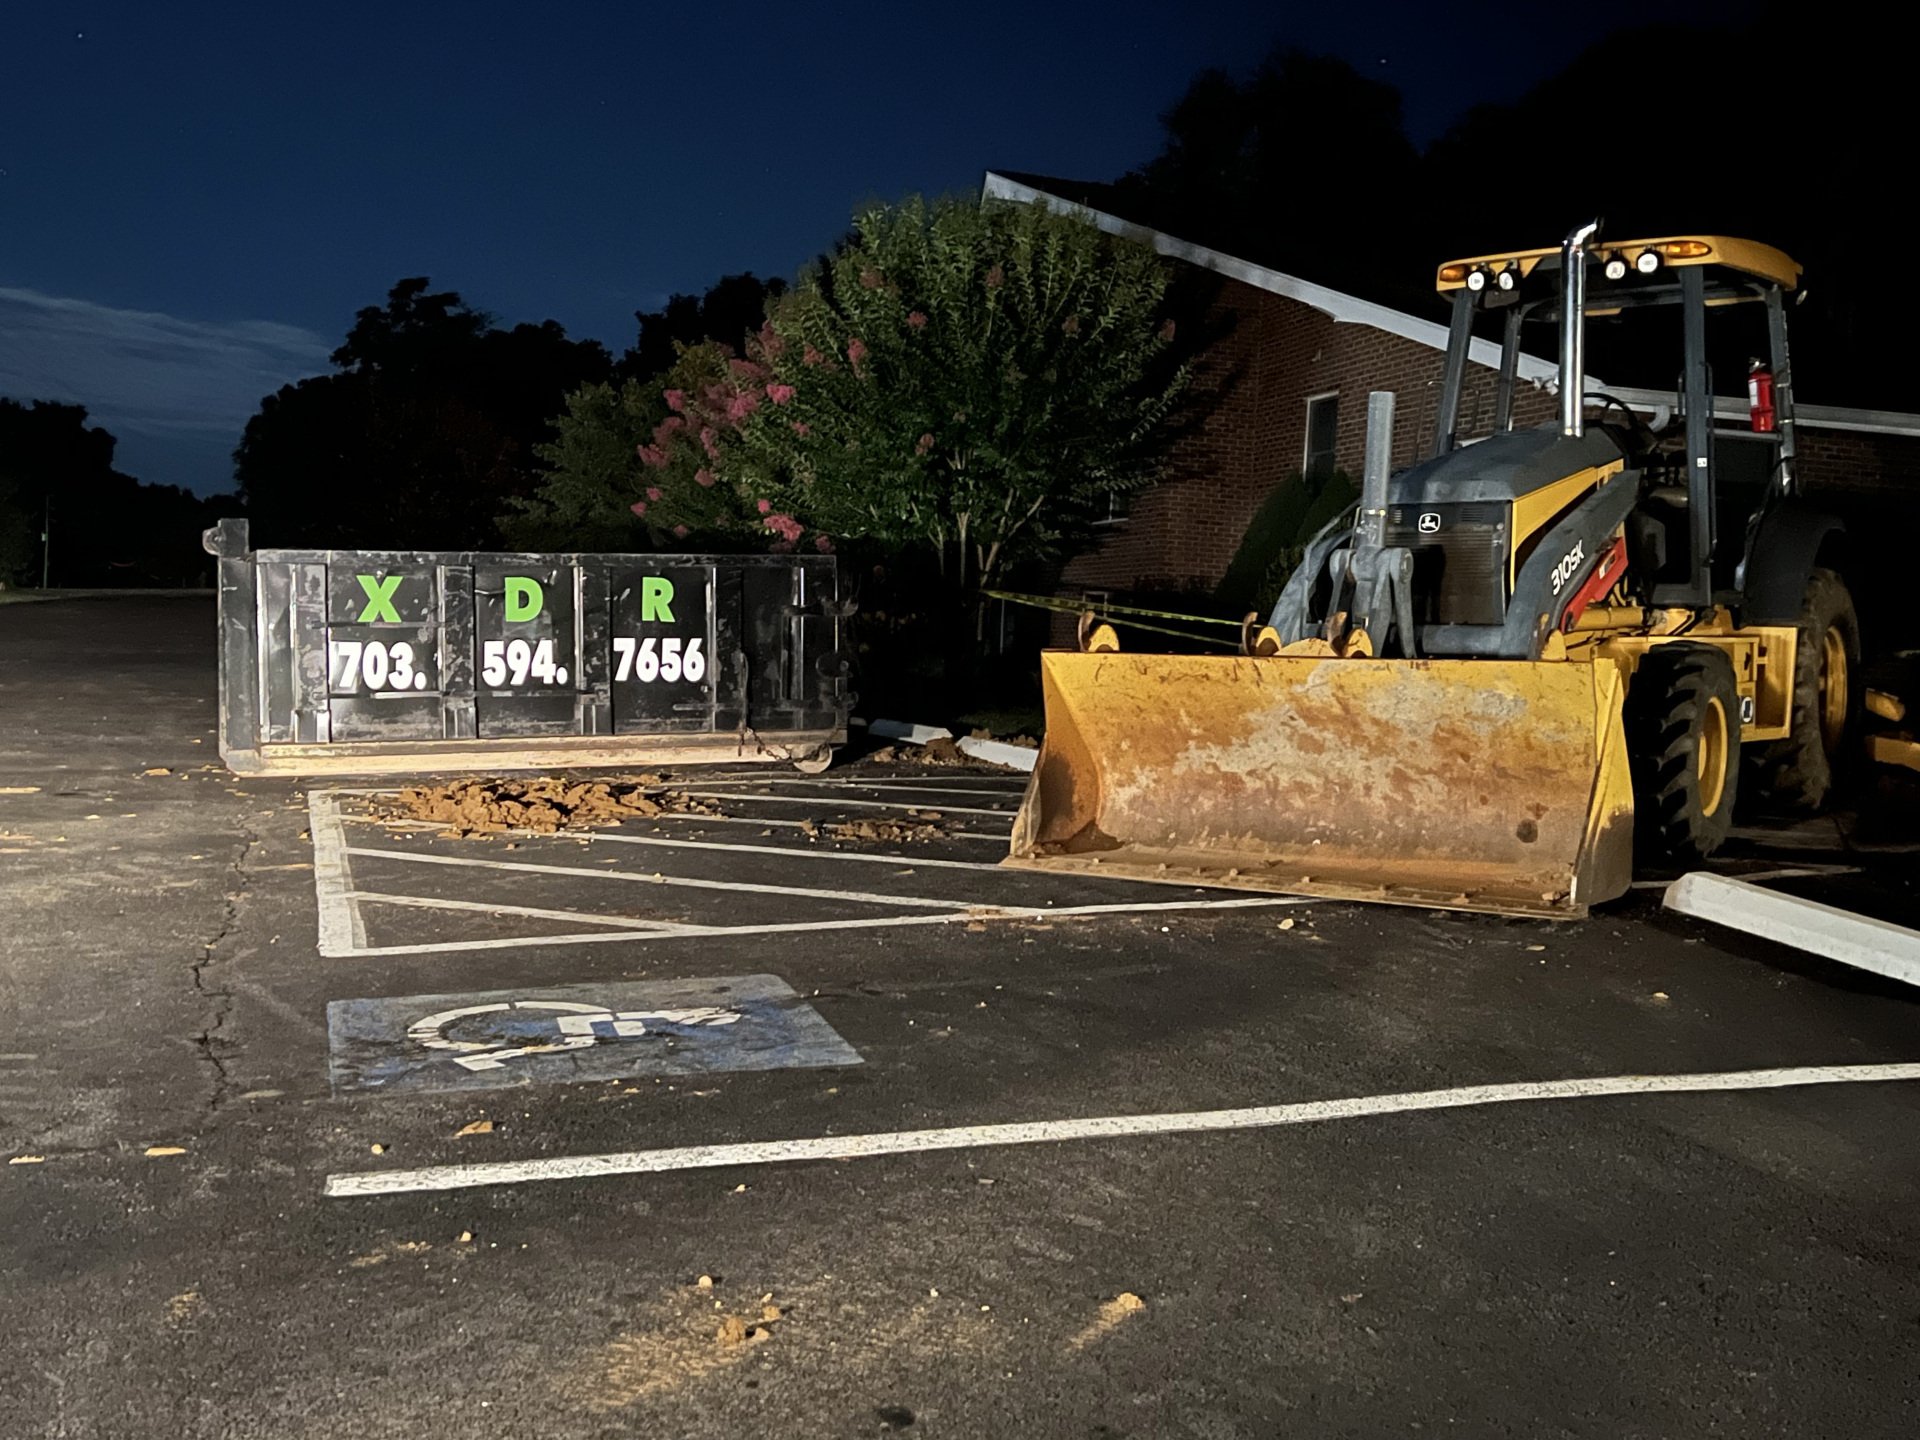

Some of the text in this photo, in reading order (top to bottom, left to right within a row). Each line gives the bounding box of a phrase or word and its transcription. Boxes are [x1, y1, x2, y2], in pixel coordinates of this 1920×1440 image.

[1551, 539, 1584, 595] 310SK
[356, 575, 675, 622] X D R
[335, 637, 705, 690] 703. 594. 7656
